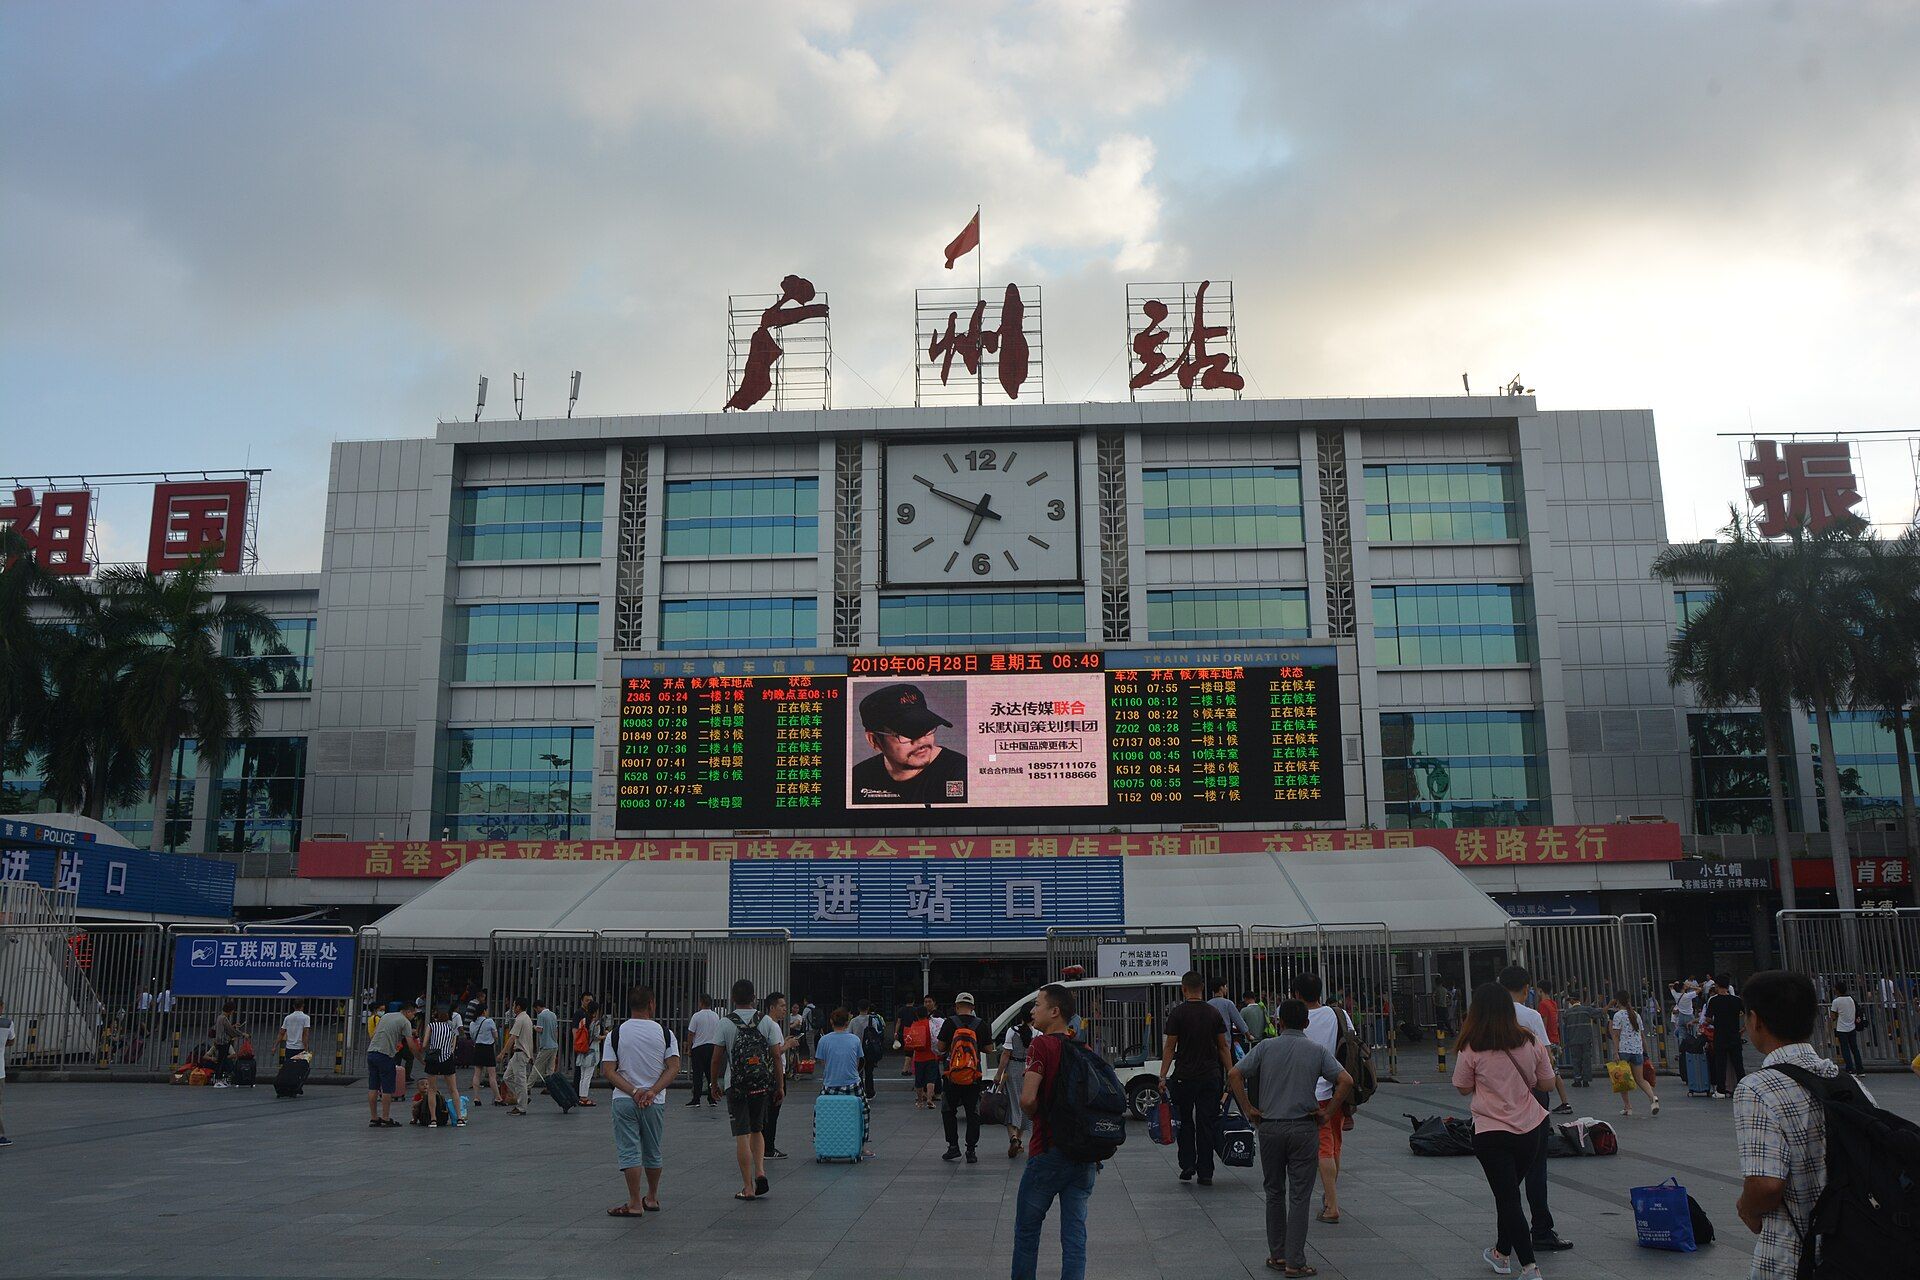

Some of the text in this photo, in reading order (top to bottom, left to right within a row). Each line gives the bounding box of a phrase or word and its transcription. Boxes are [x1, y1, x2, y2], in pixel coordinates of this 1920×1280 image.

[723, 275, 1245, 412] 广州站
[965, 449, 997, 471] 12
[1744, 440, 1870, 538] 振
[897, 503, 916, 524] 9
[1047, 499, 1065, 521] 3
[972, 553, 991, 575] 6
[852, 654, 1099, 672] 2019年06月28日 星期五 06:49
[1144, 653, 1300, 663] TRAIN INFORMATION
[1115, 667, 1303, 681] 车次 开点 候/乘车地点 状态
[629, 676, 812, 689] 车次 开点 候/乘车地点 状态
[1114, 684, 1138, 693] K951
[1147, 684, 1177, 693] 07:55
[1270, 680, 1315, 691] 正在候车
[627, 693, 650, 702] Z385
[658, 692, 688, 700] 05:24
[762, 689, 838, 700] 约晚点至08:15
[1112, 698, 1142, 707] K1160
[1148, 697, 1178, 706] 08:12
[1270, 694, 1316, 704] 正在候车
[624, 706, 653, 714] C7073
[658, 706, 687, 714] 07:19
[777, 702, 822, 713] 正在候车
[990, 700, 1086, 716] 永达传媒联合
[1115, 711, 1140, 719] Z138
[1148, 710, 1178, 719] 08:22
[1271, 707, 1317, 718] 正在候车
[623, 719, 652, 727] K9083
[658, 718, 687, 727] 07:26
[777, 716, 822, 726] 正在候车
[978, 720, 1098, 734] 张默闻策划集团
[1116, 724, 1140, 733] Z202
[1148, 723, 1179, 732] 08:28
[1271, 720, 1318, 731] 正在候车
[623, 732, 651, 740] D1849
[657, 732, 687, 740] 07:28
[777, 729, 822, 739] 正在候车
[1113, 738, 1143, 747] C7137
[1149, 737, 1180, 746] 08:30
[1272, 734, 1318, 745] 正在候车
[626, 745, 648, 754] Z112
[657, 745, 687, 753] 07:36
[776, 742, 822, 753] 正在候车
[999, 740, 1078, 750] 让中国品牌更伟大
[1113, 751, 1144, 760] K1096
[1149, 751, 1180, 759] 08:45
[1273, 747, 1319, 758] 正在候车
[622, 759, 651, 767] K9017
[656, 759, 685, 767] 07:41
[776, 756, 822, 766] 正在候车
[1028, 762, 1097, 770] 18957111076
[1116, 765, 1141, 774] K512
[1150, 764, 1180, 773] 08:54
[1273, 761, 1320, 772] 正在候车
[624, 772, 648, 781] K528
[656, 772, 686, 780] 07:45
[776, 769, 822, 780] 正在候车
[979, 767, 1024, 775] 联合合作热线
[1028, 772, 1097, 780] 18511188666
[1113, 779, 1145, 788] K9075
[1150, 778, 1181, 787] 08:55
[1274, 775, 1320, 786] 正在候车
[621, 786, 649, 794] C6871
[656, 786, 685, 794] 07:47
[776, 783, 822, 794] 正在候车
[1117, 793, 1141, 802] T152
[1151, 792, 1181, 801] 09:00
[1275, 788, 1321, 799] 正在候车
[621, 799, 650, 808] K9063
[656, 799, 685, 807] 07:48
[776, 797, 821, 807] 正在候车
[5, 824, 76, 845] 警察 POLICE
[1455, 826, 1608, 862] 铁路先行
[1, 850, 128, 895] 进站口
[1700, 862, 1742, 877] 小红帽
[1856, 860, 1912, 883] 肯德
[1680, 880, 1724, 889] 客搬运行李
[812, 874, 1044, 922] 进站口
[220, 940, 338, 961] 互联网取票处
[1120, 950, 1168, 959] 广州站进站口
[219, 959, 334, 970] 12306 Automatic Ticketing
[1120, 959, 1168, 968] 停止营业时间
